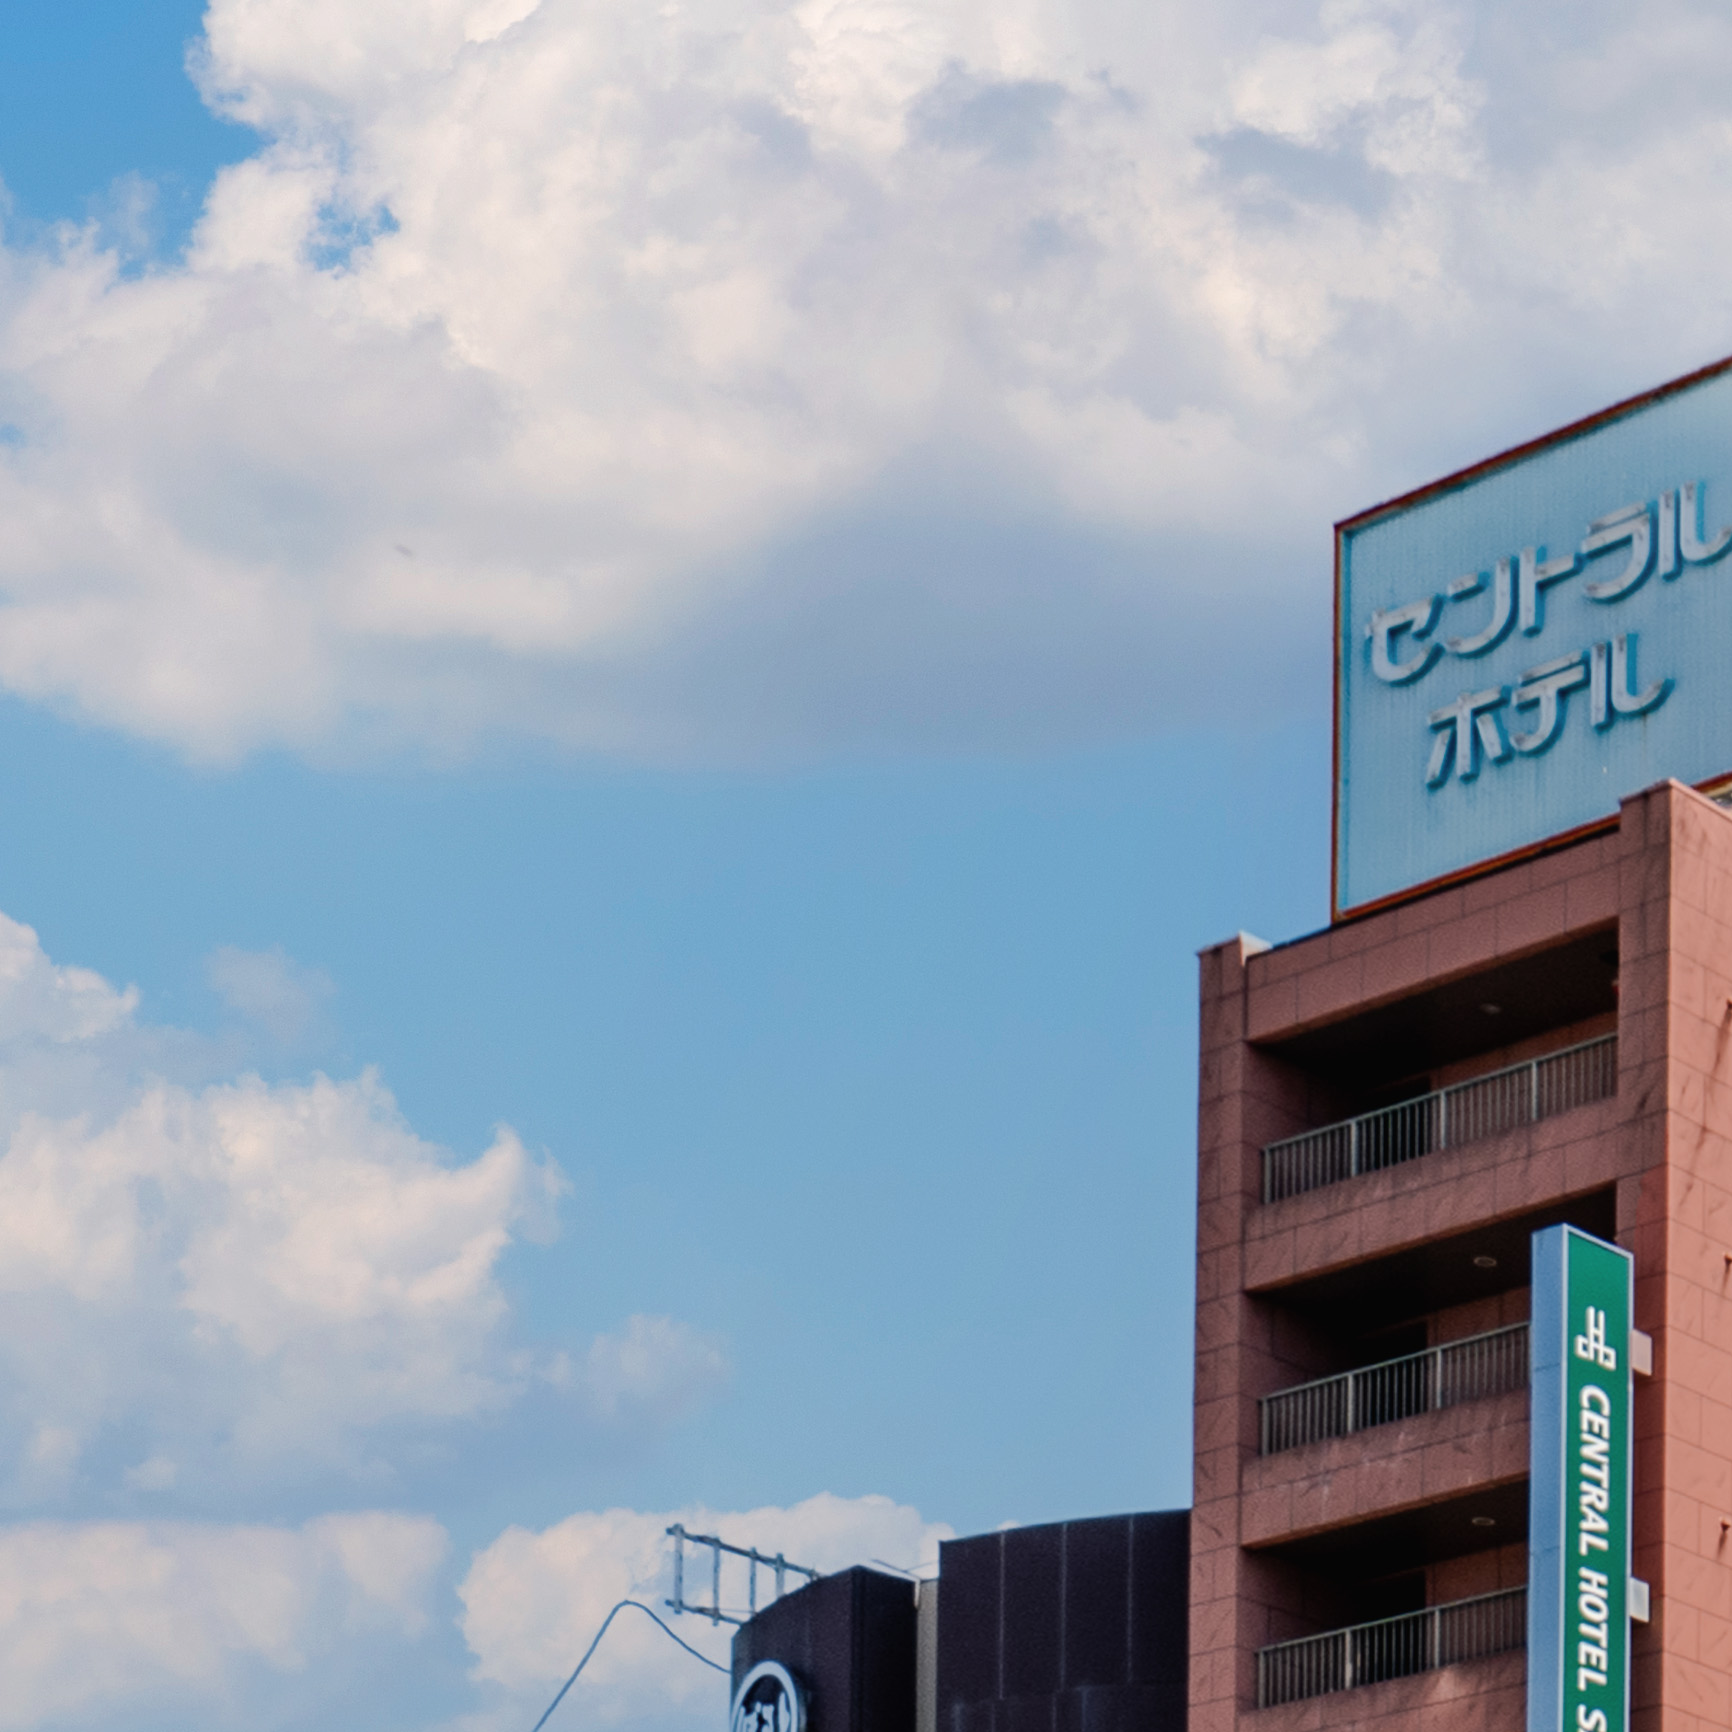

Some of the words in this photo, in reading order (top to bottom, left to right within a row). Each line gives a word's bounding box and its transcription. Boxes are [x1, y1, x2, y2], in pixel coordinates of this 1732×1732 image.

[1425, 631, 1676, 790] ホテル
[1578, 1382, 1611, 1556] CENTRAL
[1577, 1562, 1610, 1694] HOTEL
